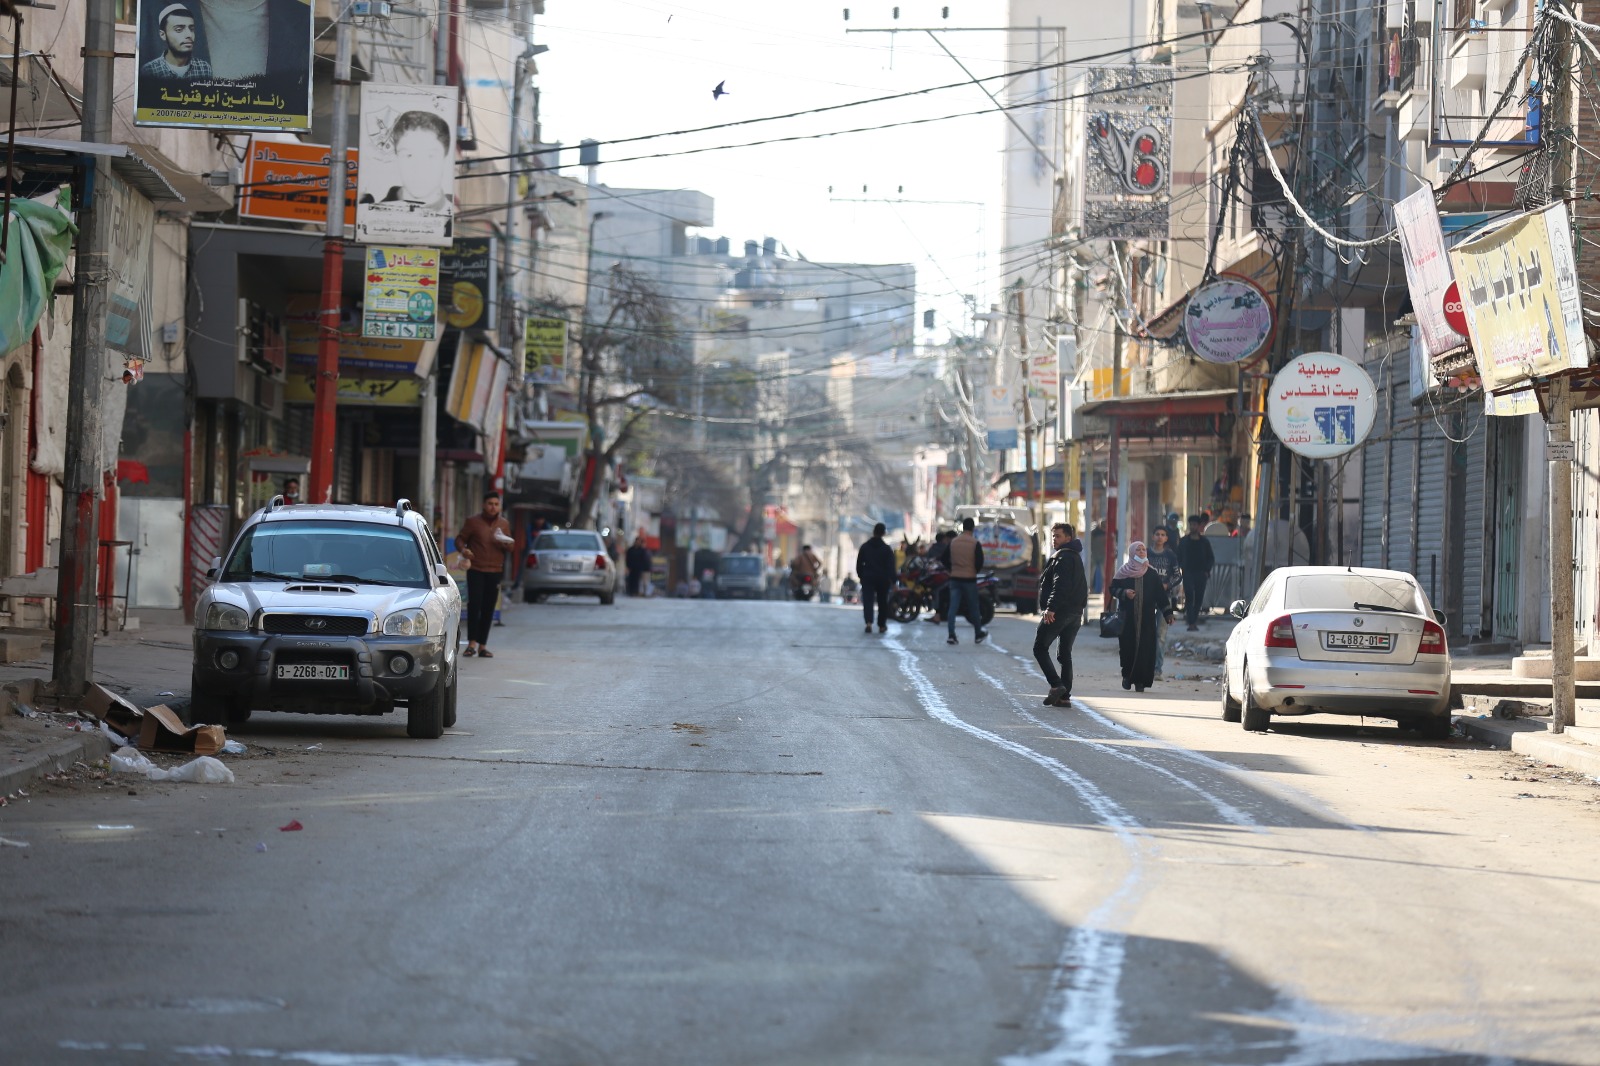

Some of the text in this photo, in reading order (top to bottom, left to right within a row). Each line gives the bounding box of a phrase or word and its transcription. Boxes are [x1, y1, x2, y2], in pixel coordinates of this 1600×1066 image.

[204, 90, 219, 107] أبو
[221, 90, 250, 108] أمين
[253, 93, 285, 109] رائد
[156, 109, 192, 118] 2007/6/27
[1298, 363, 1341, 379] صيدلية
[1280, 384, 1359, 400] بيت المقدس
[1283, 434, 1311, 445] لطيف
[1329, 634, 1378, 646] 3-4882-01
